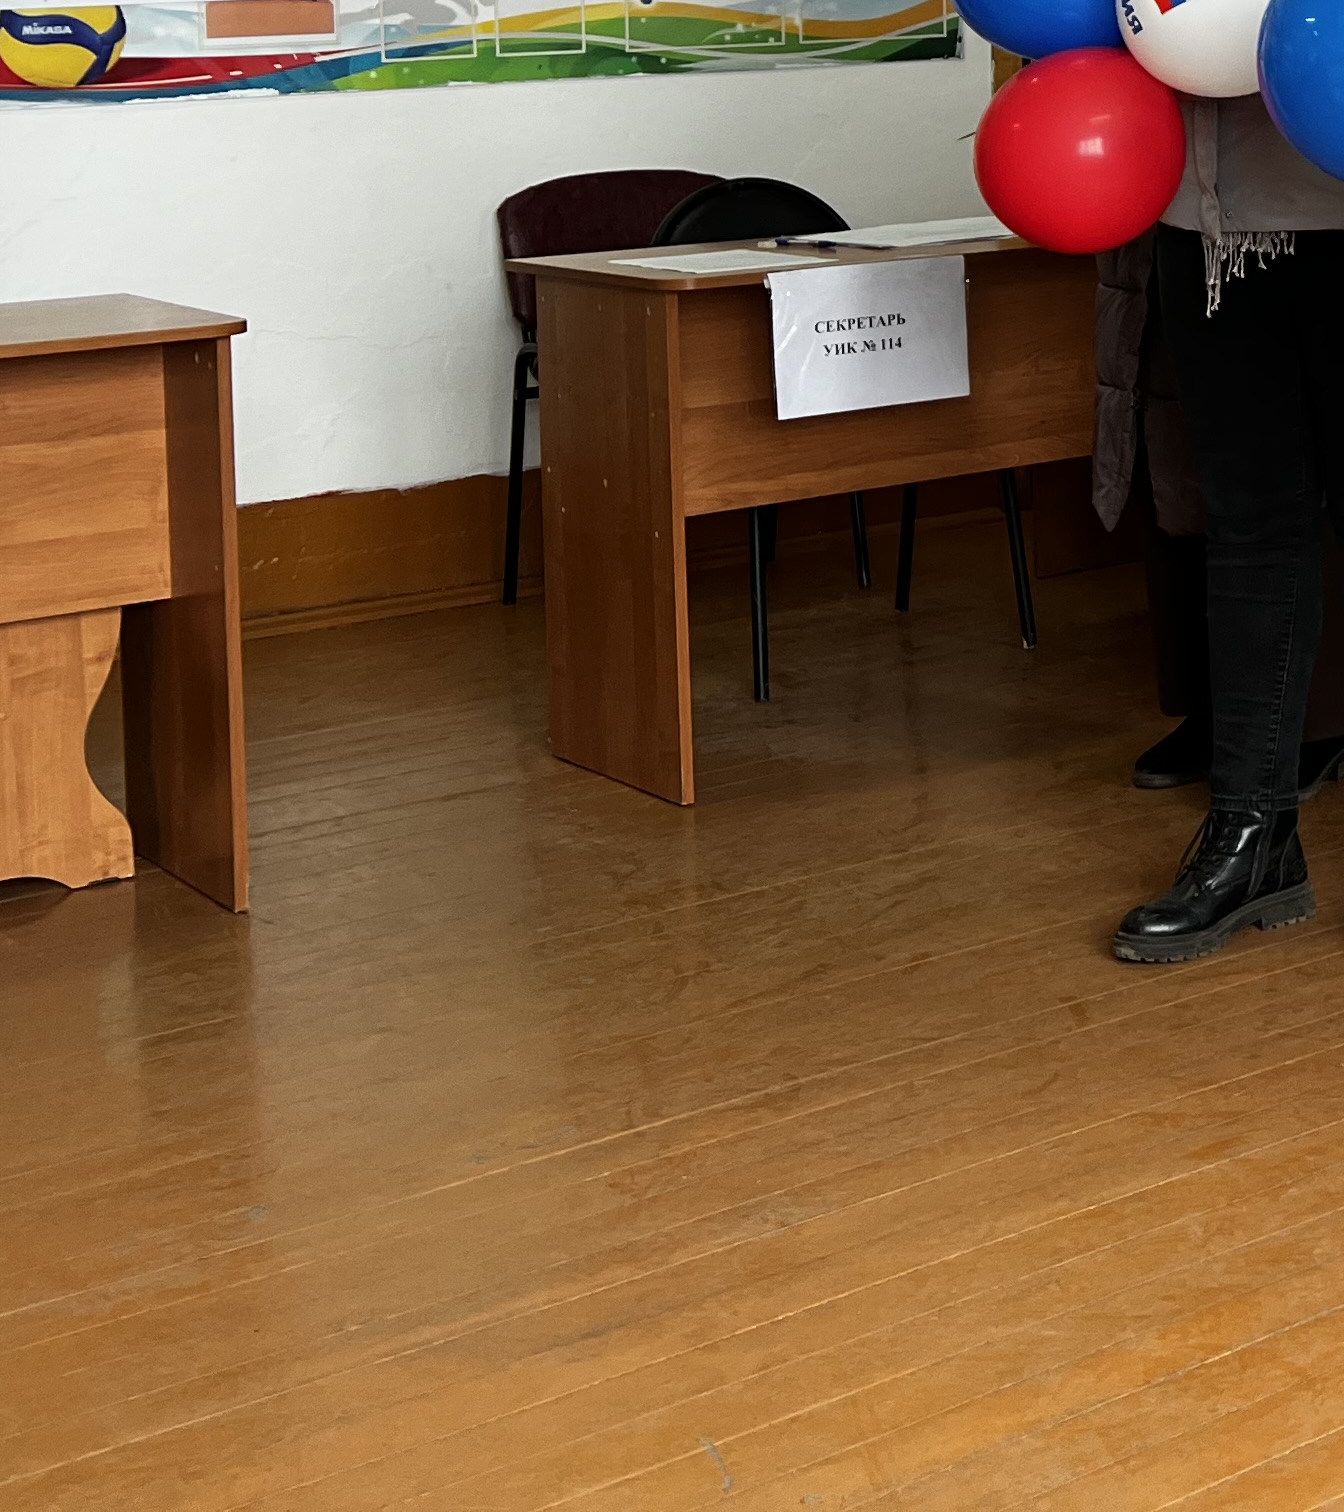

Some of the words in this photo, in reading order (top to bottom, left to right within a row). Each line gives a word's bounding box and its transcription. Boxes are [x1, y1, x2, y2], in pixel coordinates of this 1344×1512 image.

[814, 312, 906, 334] СЕКРЕТАРЬ
[823, 340, 858, 357] УИК
[860, 339, 877, 353] №
[881, 336, 903, 350] 114
